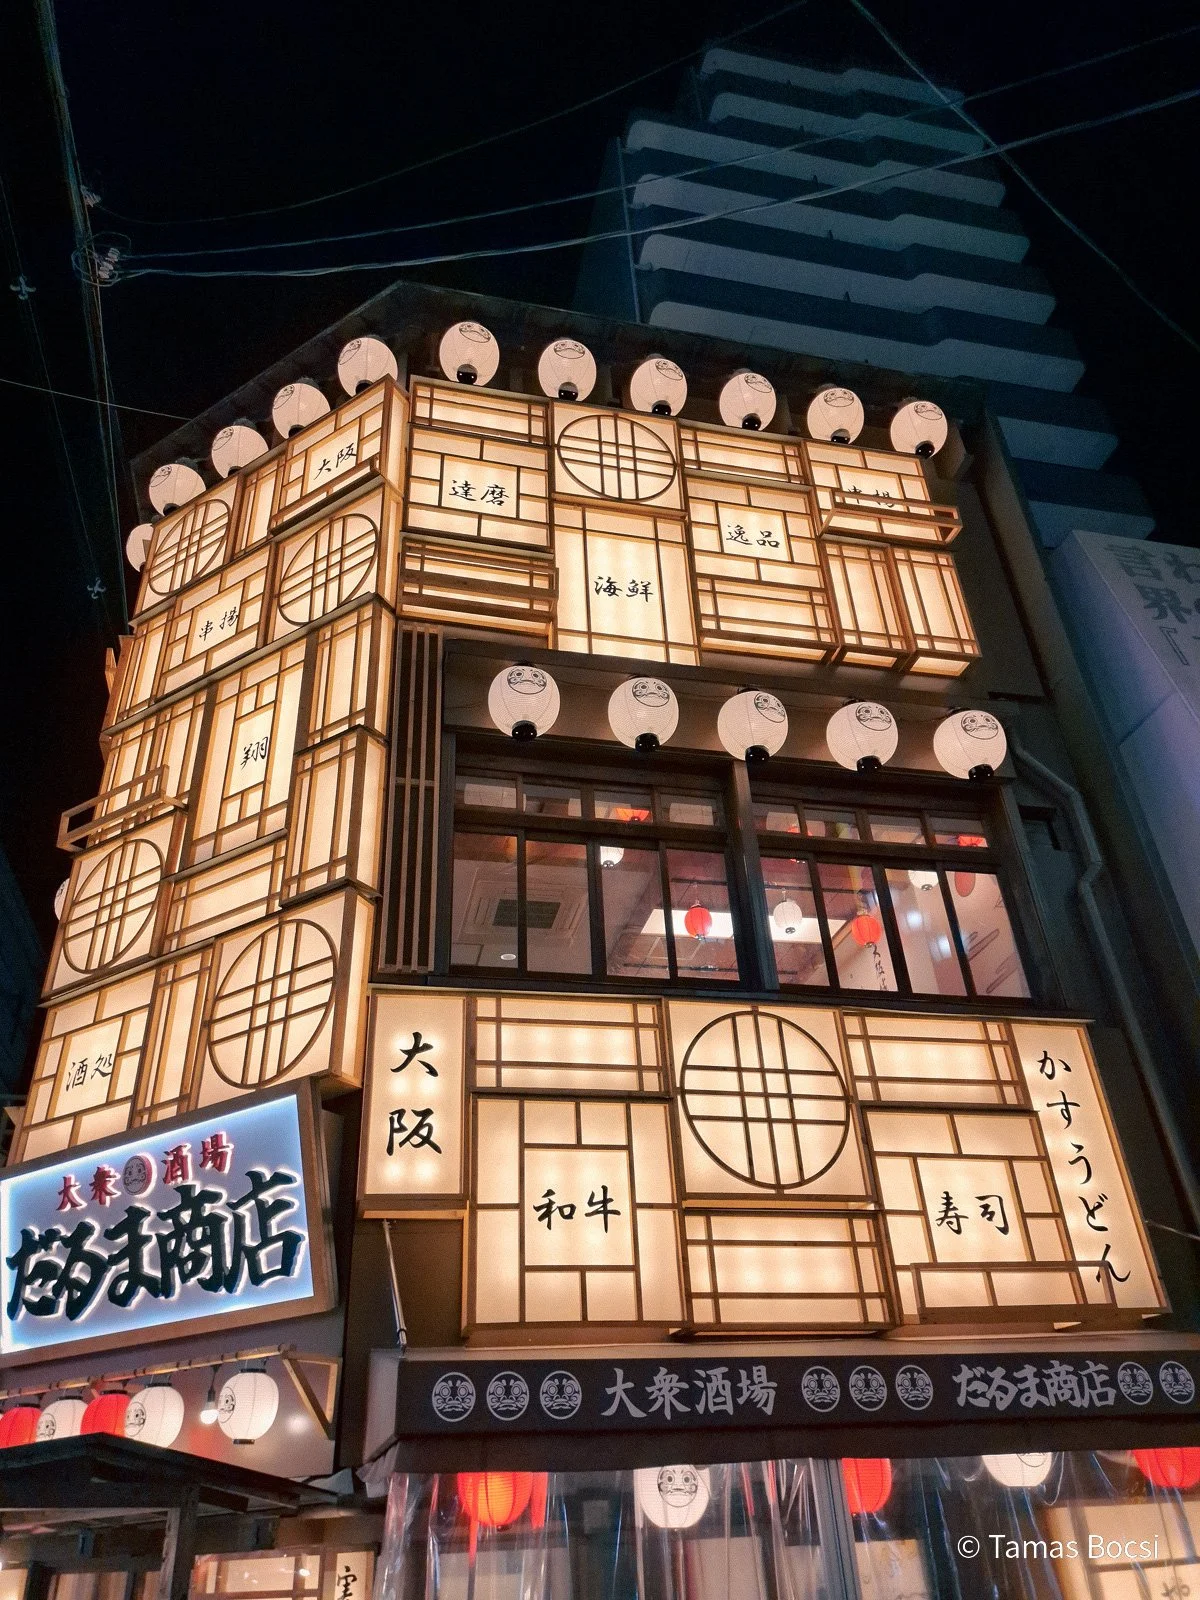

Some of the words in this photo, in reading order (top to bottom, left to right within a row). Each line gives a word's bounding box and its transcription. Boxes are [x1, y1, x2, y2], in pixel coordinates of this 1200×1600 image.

[313, 442, 357, 480] 大阪
[448, 479, 510, 507] 達磨
[725, 524, 781, 548] 逸品
[594, 575, 654, 603] 海鮮
[198, 606, 239, 642] 串揚
[240, 736, 269, 770] 翔
[65, 1053, 113, 1092] 酒処
[386, 1031, 443, 1156] 大阪
[1036, 1050, 1132, 1284] かすうどん
[532, 1184, 622, 1234] 和牛
[935, 1190, 1010, 1236] 寿司
[5, 1169, 305, 1321] だるま商店
[600, 1365, 778, 1421] 大衆酒場
[952, 1359, 1117, 1411] だるま商店
